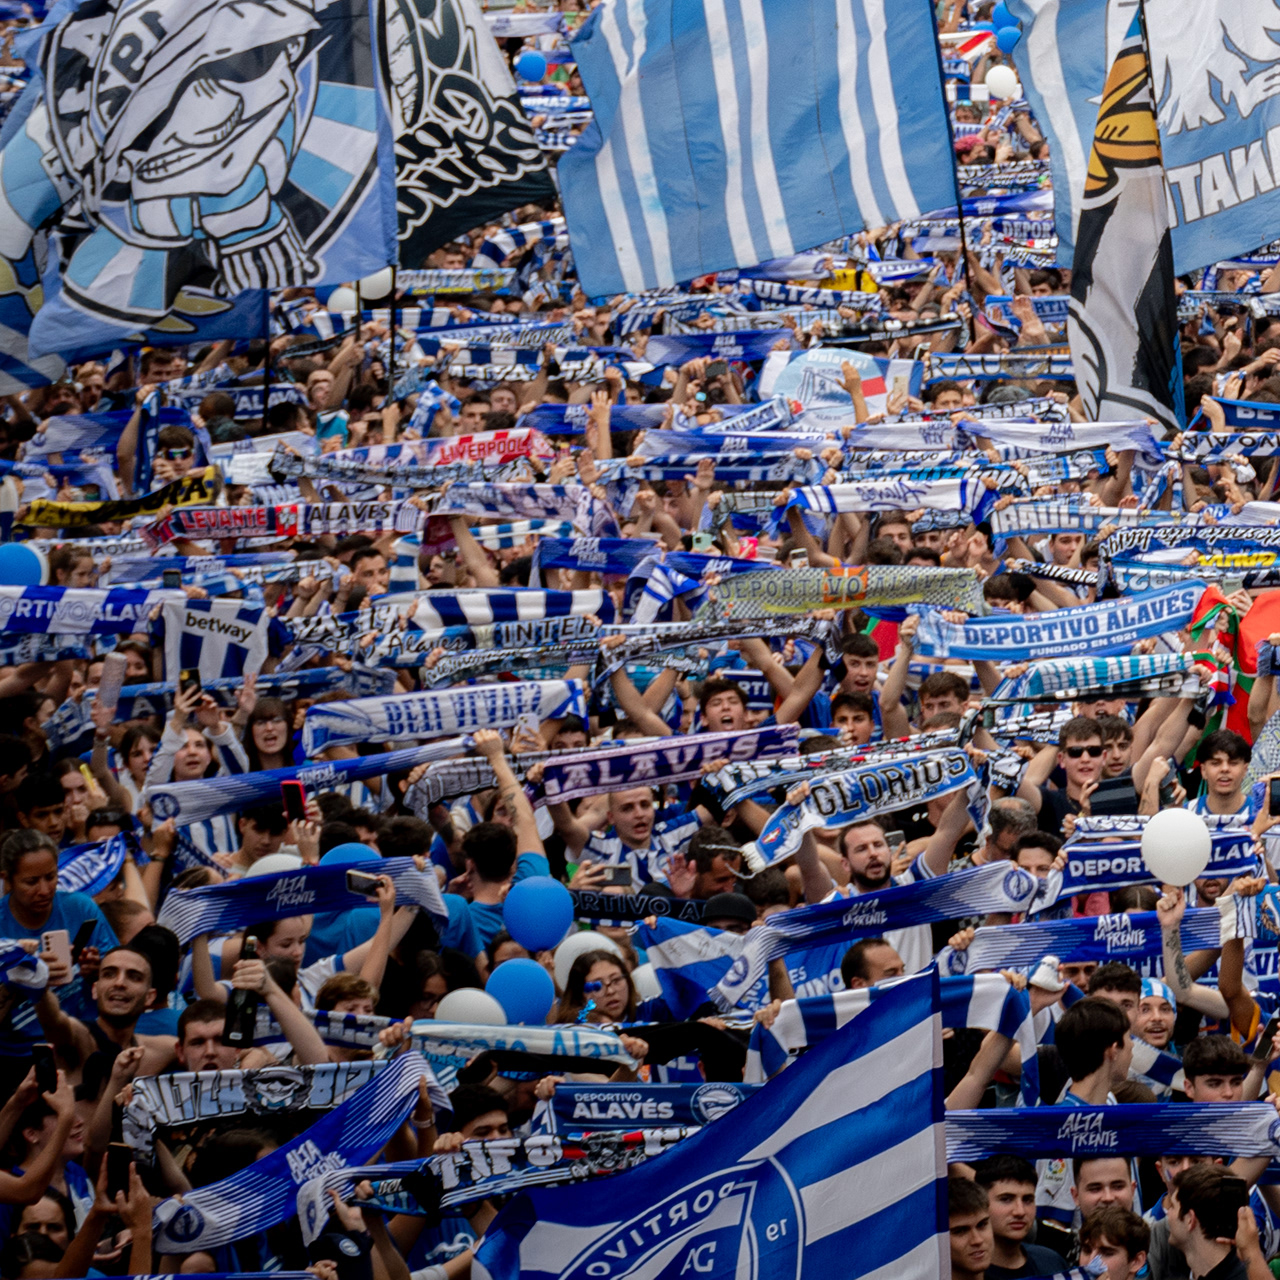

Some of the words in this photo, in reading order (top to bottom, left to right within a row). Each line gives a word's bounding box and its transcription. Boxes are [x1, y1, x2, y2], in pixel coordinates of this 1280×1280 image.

[183, 509, 267, 528] LEVANTE
[309, 504, 390, 521] ALAVES
[963, 611, 1102, 646] DEPORTIVO
[1107, 590, 1196, 631] ALAVÉS
[186, 613, 251, 642] betway
[1030, 642, 1079, 657] FUNDADO
[1083, 640, 1096, 650] EN
[1100, 632, 1138, 647] 1921
[275, 876, 305, 894] ALTA
[277, 890, 314, 905] FRENTE
[1098, 914, 1130, 931] ALTA
[1106, 931, 1146, 952] FRENTE
[575, 1093, 641, 1102] DEPORTIVO
[574, 1101, 674, 1118] ALAVÉS
[1064, 1112, 1103, 1130] ALTA
[1071, 1131, 1118, 1148] FRENTE
